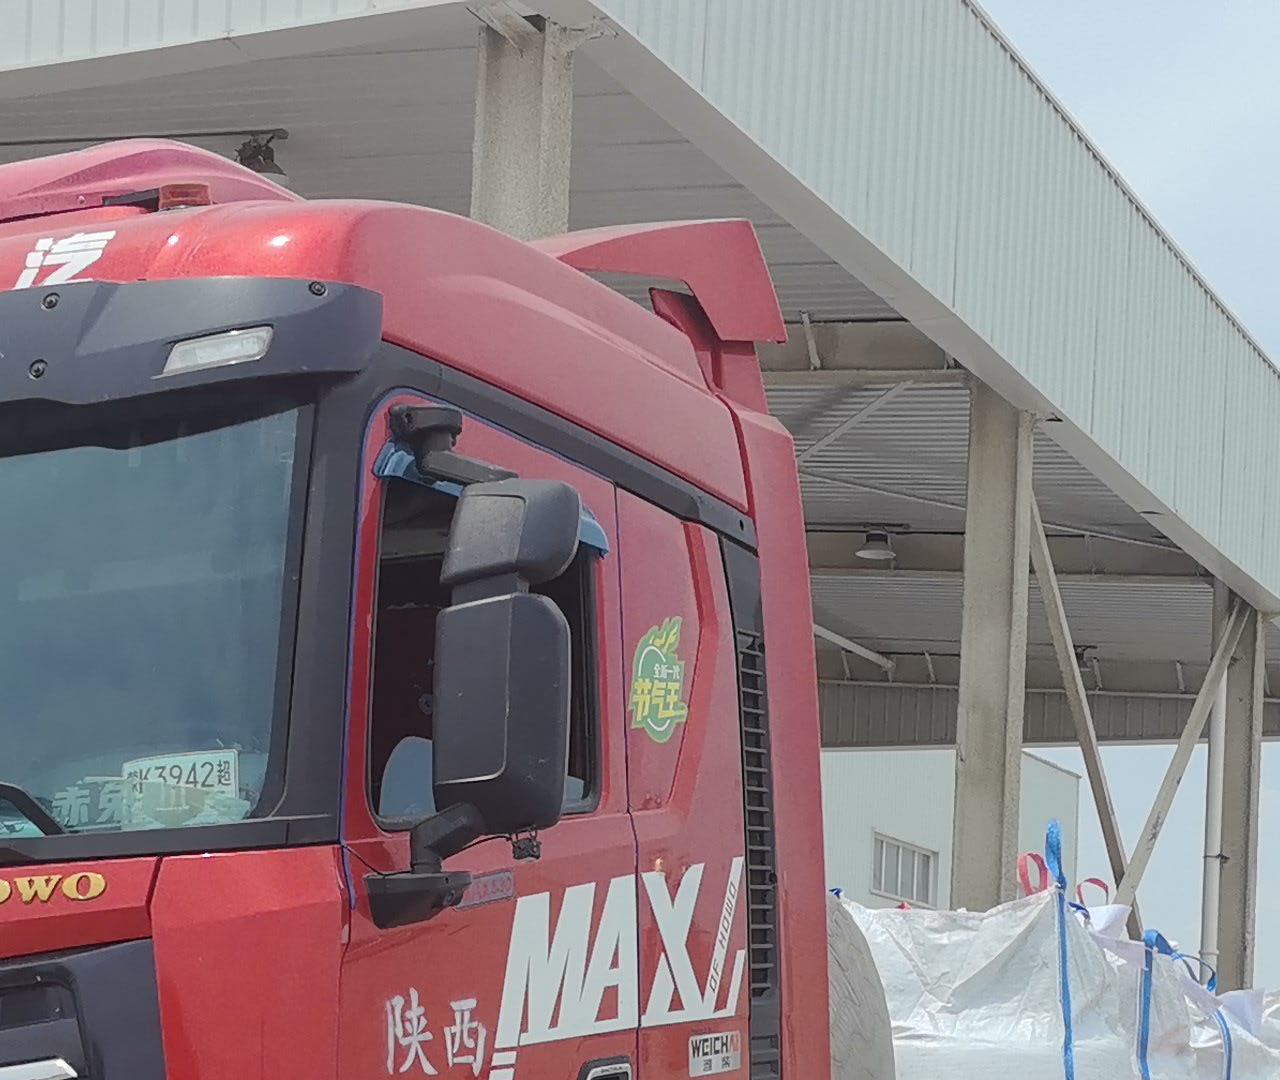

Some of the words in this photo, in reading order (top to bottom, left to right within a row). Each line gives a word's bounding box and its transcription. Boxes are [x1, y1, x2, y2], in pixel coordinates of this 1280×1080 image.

[492, 858, 732, 1050] MAX
[709, 960, 721, 994] OF
[718, 880, 738, 950] HOWO
[385, 987, 487, 1077] 陕西
